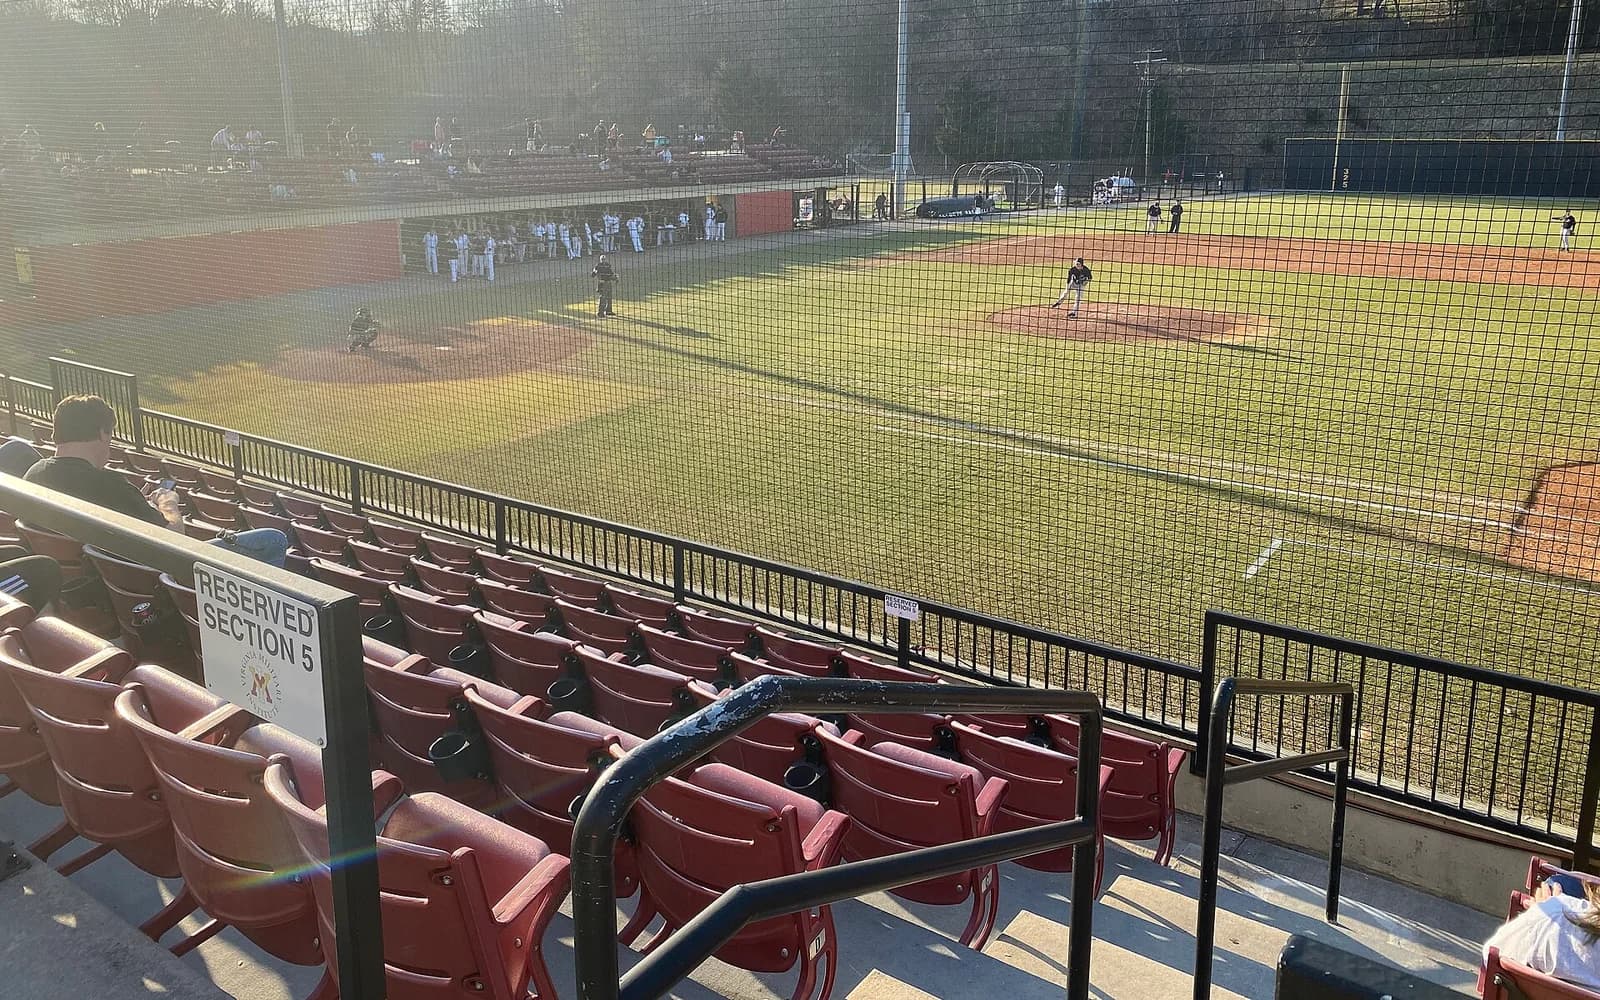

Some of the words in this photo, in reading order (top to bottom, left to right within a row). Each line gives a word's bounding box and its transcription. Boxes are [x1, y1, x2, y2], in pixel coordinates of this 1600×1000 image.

[199, 570, 313, 637] RESERVED
[886, 596, 917, 608] RESERVED
[886, 601, 911, 611] SECTION
[203, 602, 295, 665] SECTION
[302, 644, 314, 672] 5
